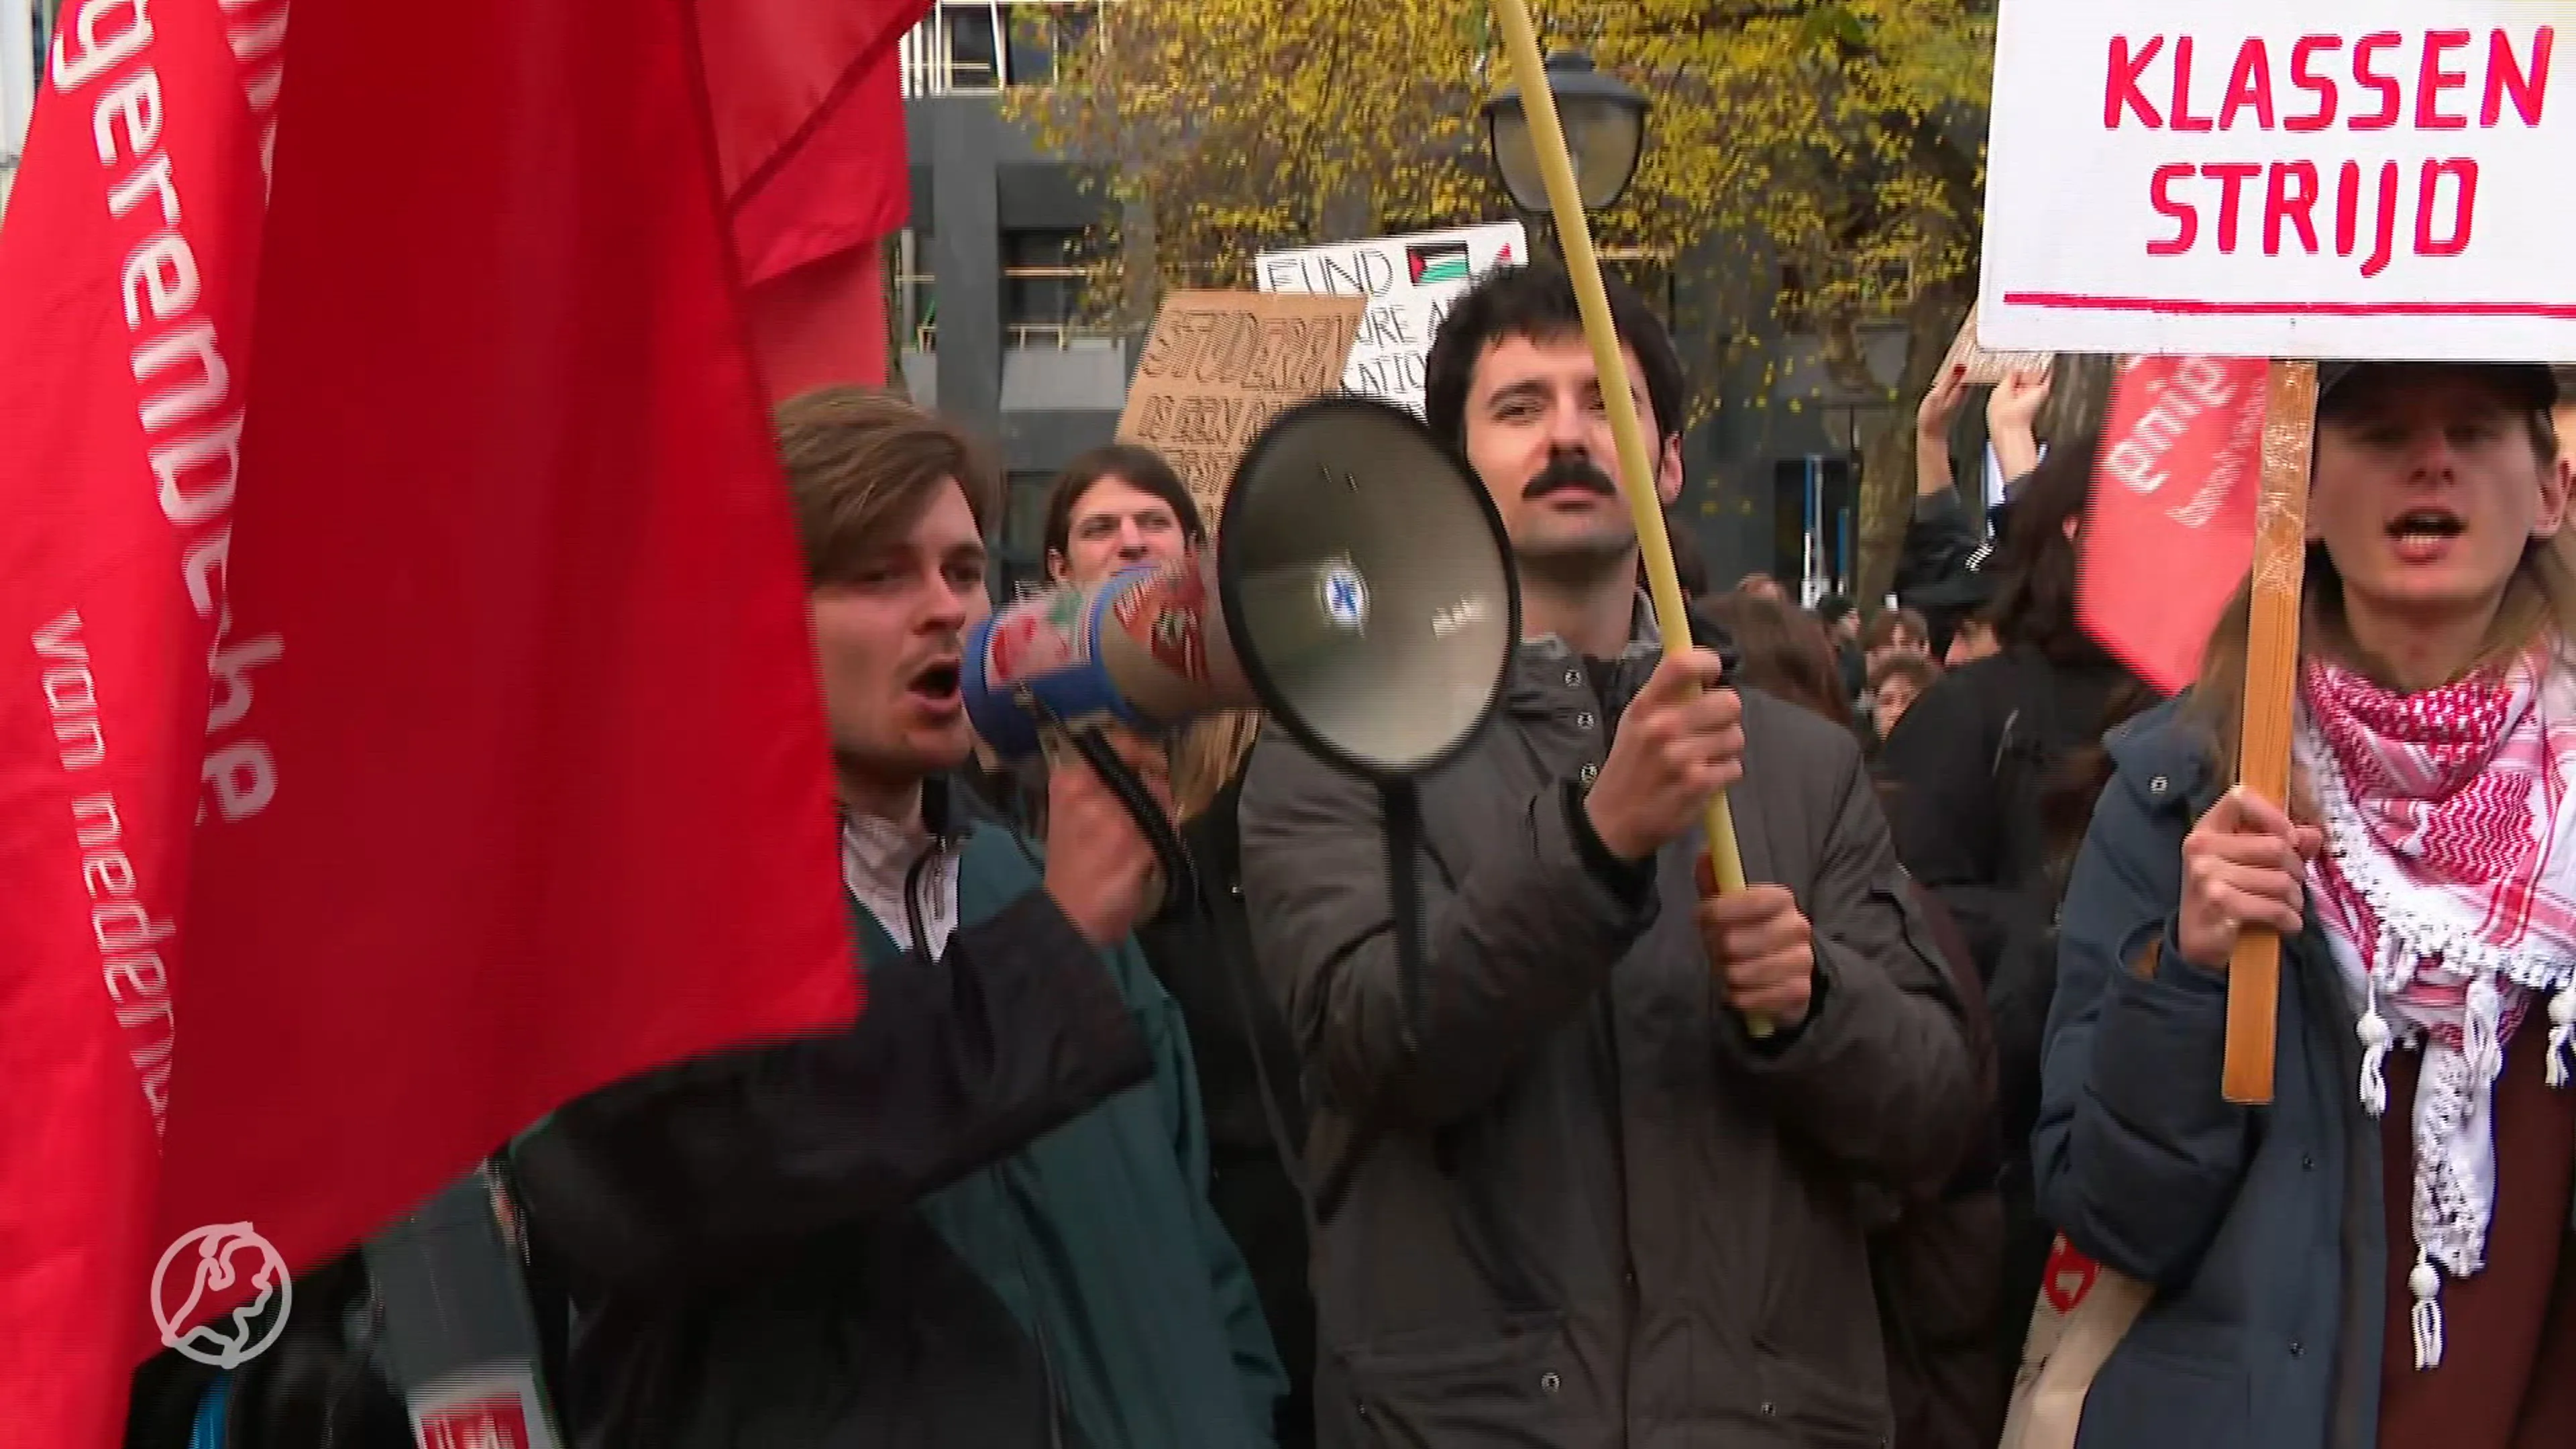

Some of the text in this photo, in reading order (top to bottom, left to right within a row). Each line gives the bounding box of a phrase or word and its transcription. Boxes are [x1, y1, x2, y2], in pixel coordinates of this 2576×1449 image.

[2103, 25, 2555, 133] KLASSEN
[2146, 156, 2479, 278] STRIJD
[1267, 250, 1393, 299] FUND
[1140, 309, 1360, 393] STUDEREN
[1137, 393, 1175, 443] IS
[1171, 394, 1243, 447] EEN
[32, 604, 106, 773] van
